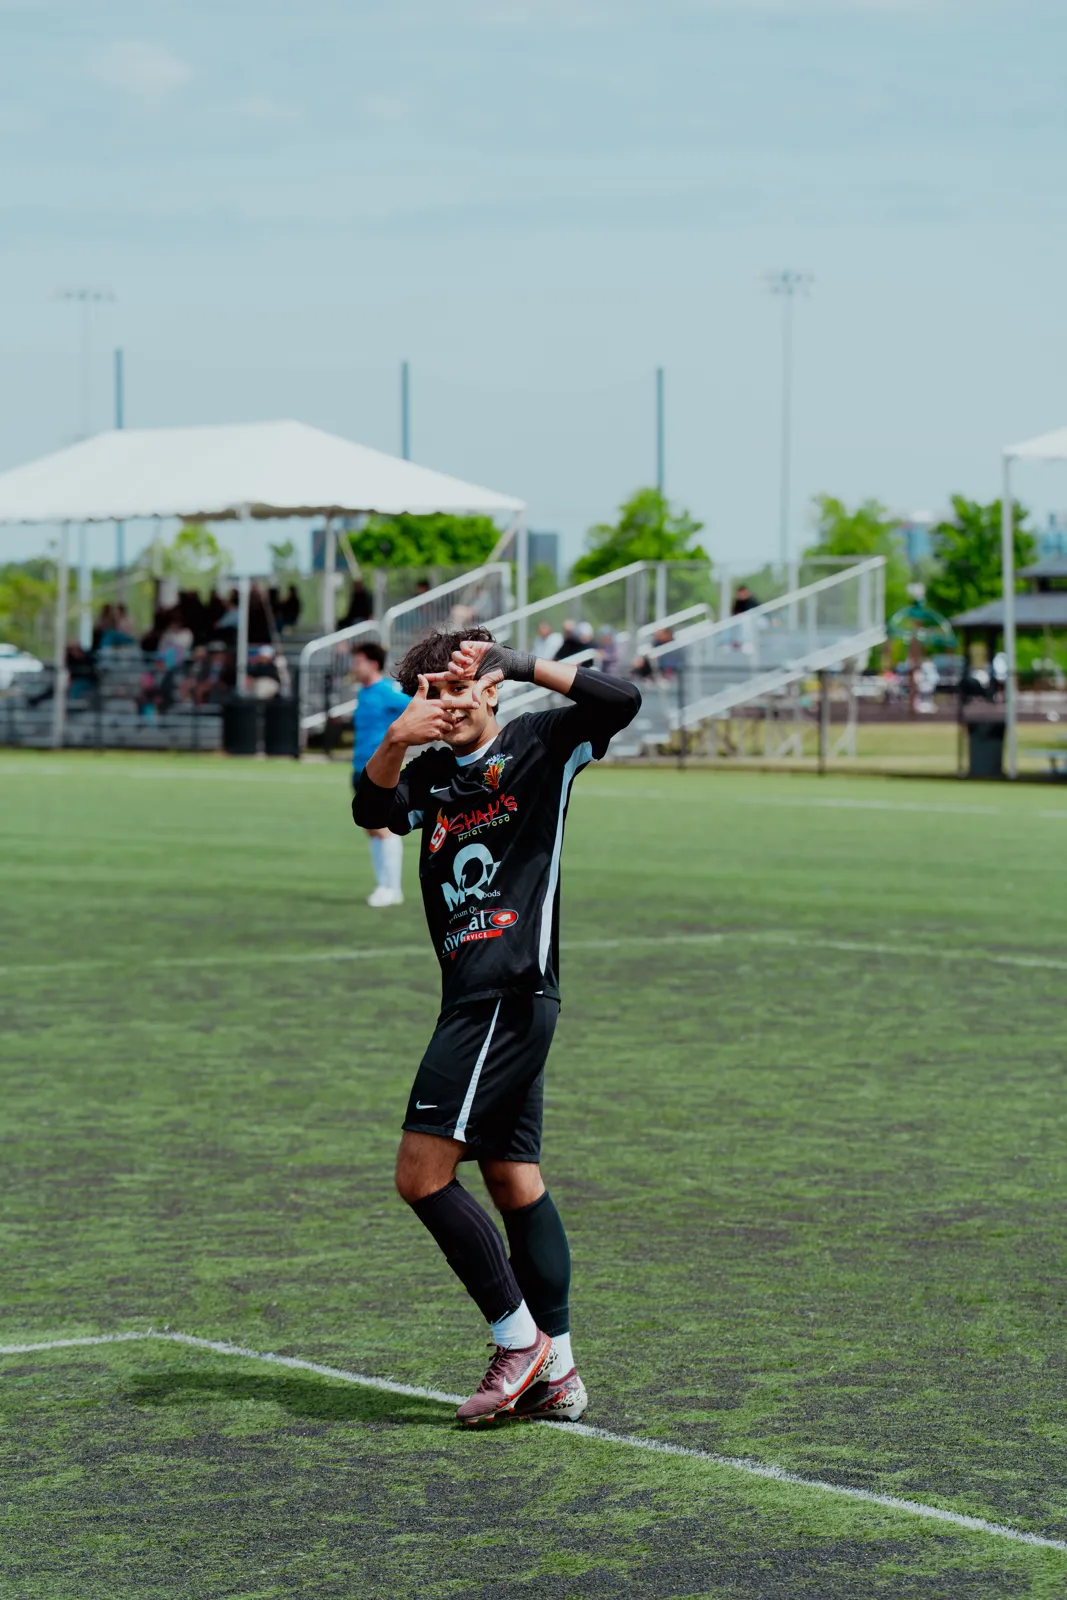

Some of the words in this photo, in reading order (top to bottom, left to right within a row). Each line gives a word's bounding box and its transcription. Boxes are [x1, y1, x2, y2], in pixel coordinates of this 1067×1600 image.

[448, 793, 517, 835] SHAH'S
[487, 816, 510, 829] ood
[483, 889, 501, 899] oods
